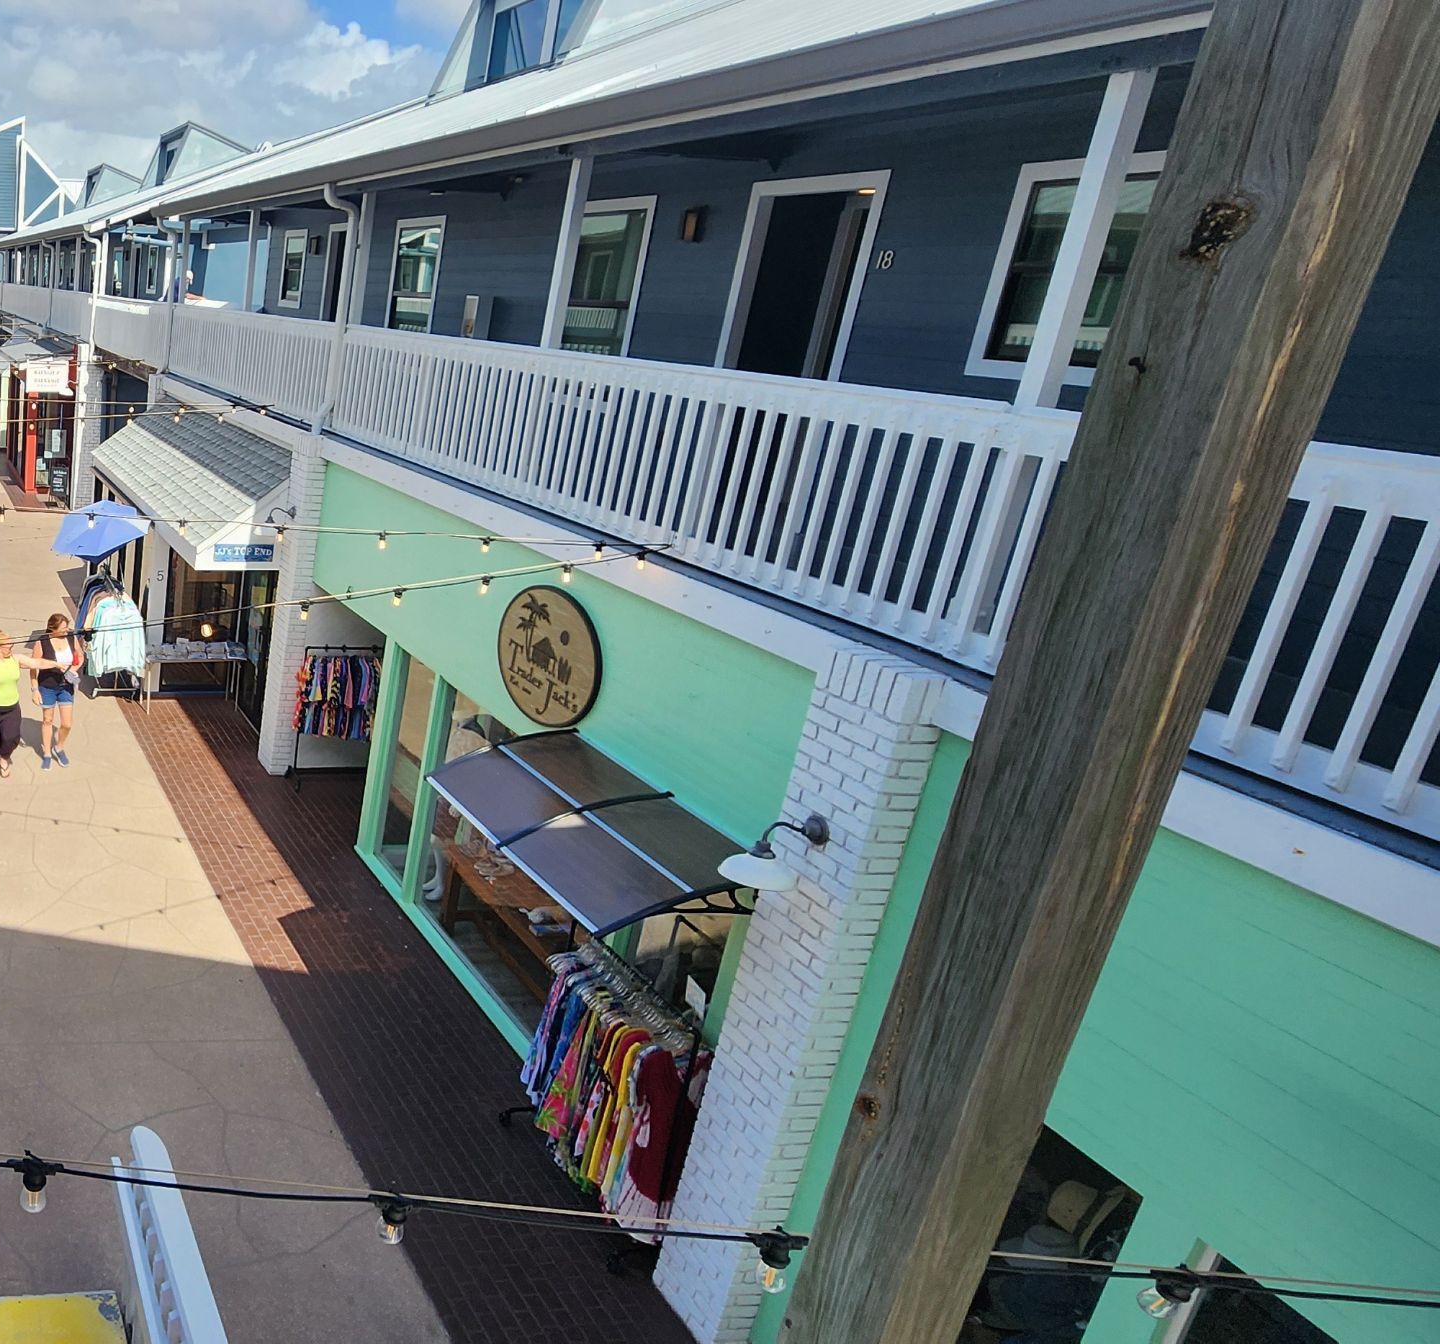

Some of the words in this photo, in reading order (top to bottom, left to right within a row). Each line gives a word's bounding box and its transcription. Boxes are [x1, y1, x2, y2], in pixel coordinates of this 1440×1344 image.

[875, 249, 894, 270] 18
[233, 546, 253, 556] TOP
[254, 547, 273, 556] END
[156, 570, 164, 582] 5
[508, 638, 543, 689] Trader
[535, 678, 578, 716] Jack's
